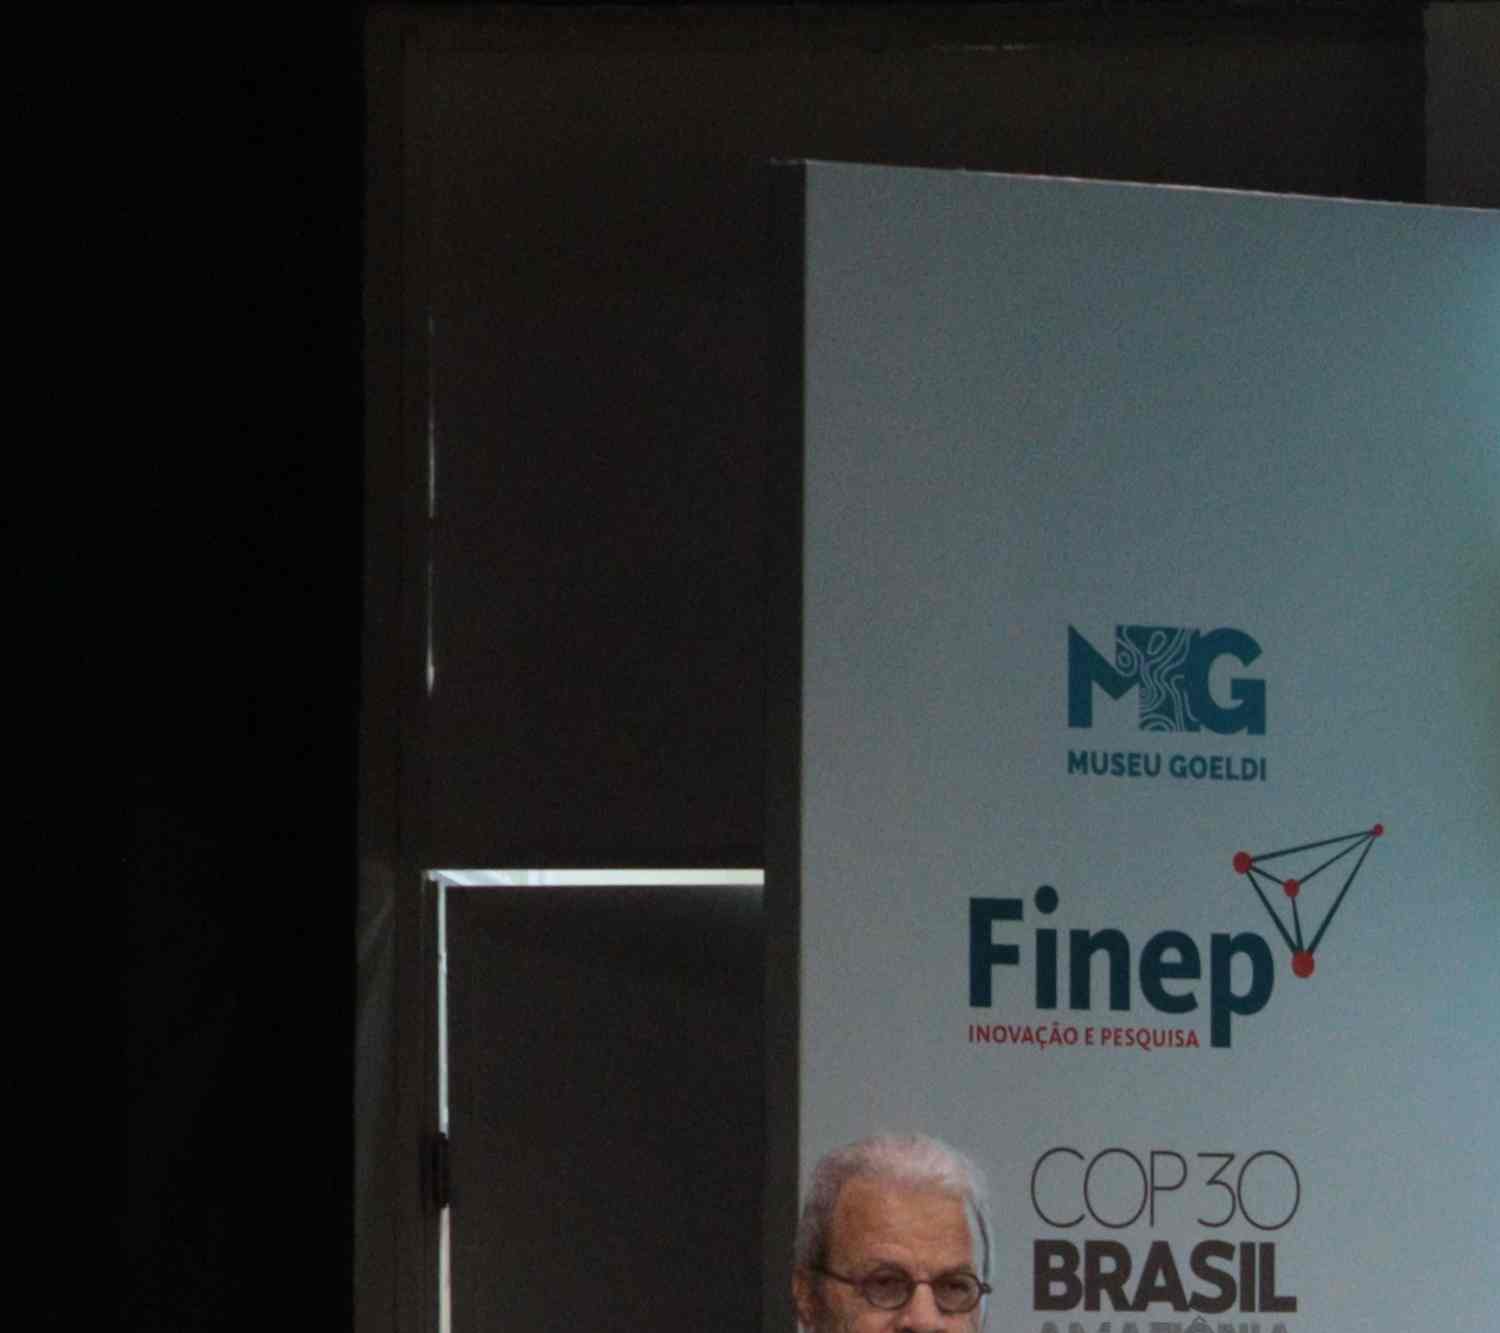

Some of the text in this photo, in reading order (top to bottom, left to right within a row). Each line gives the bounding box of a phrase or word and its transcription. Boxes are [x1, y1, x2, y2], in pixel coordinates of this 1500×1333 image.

[1067, 750, 1267, 782] MUSEU GOELDI
[969, 884, 1275, 1048] Finep
[969, 1021, 1200, 1053] INOVAÇÃO E PESQUISA
[1033, 1240, 1298, 1314] BRASIL
